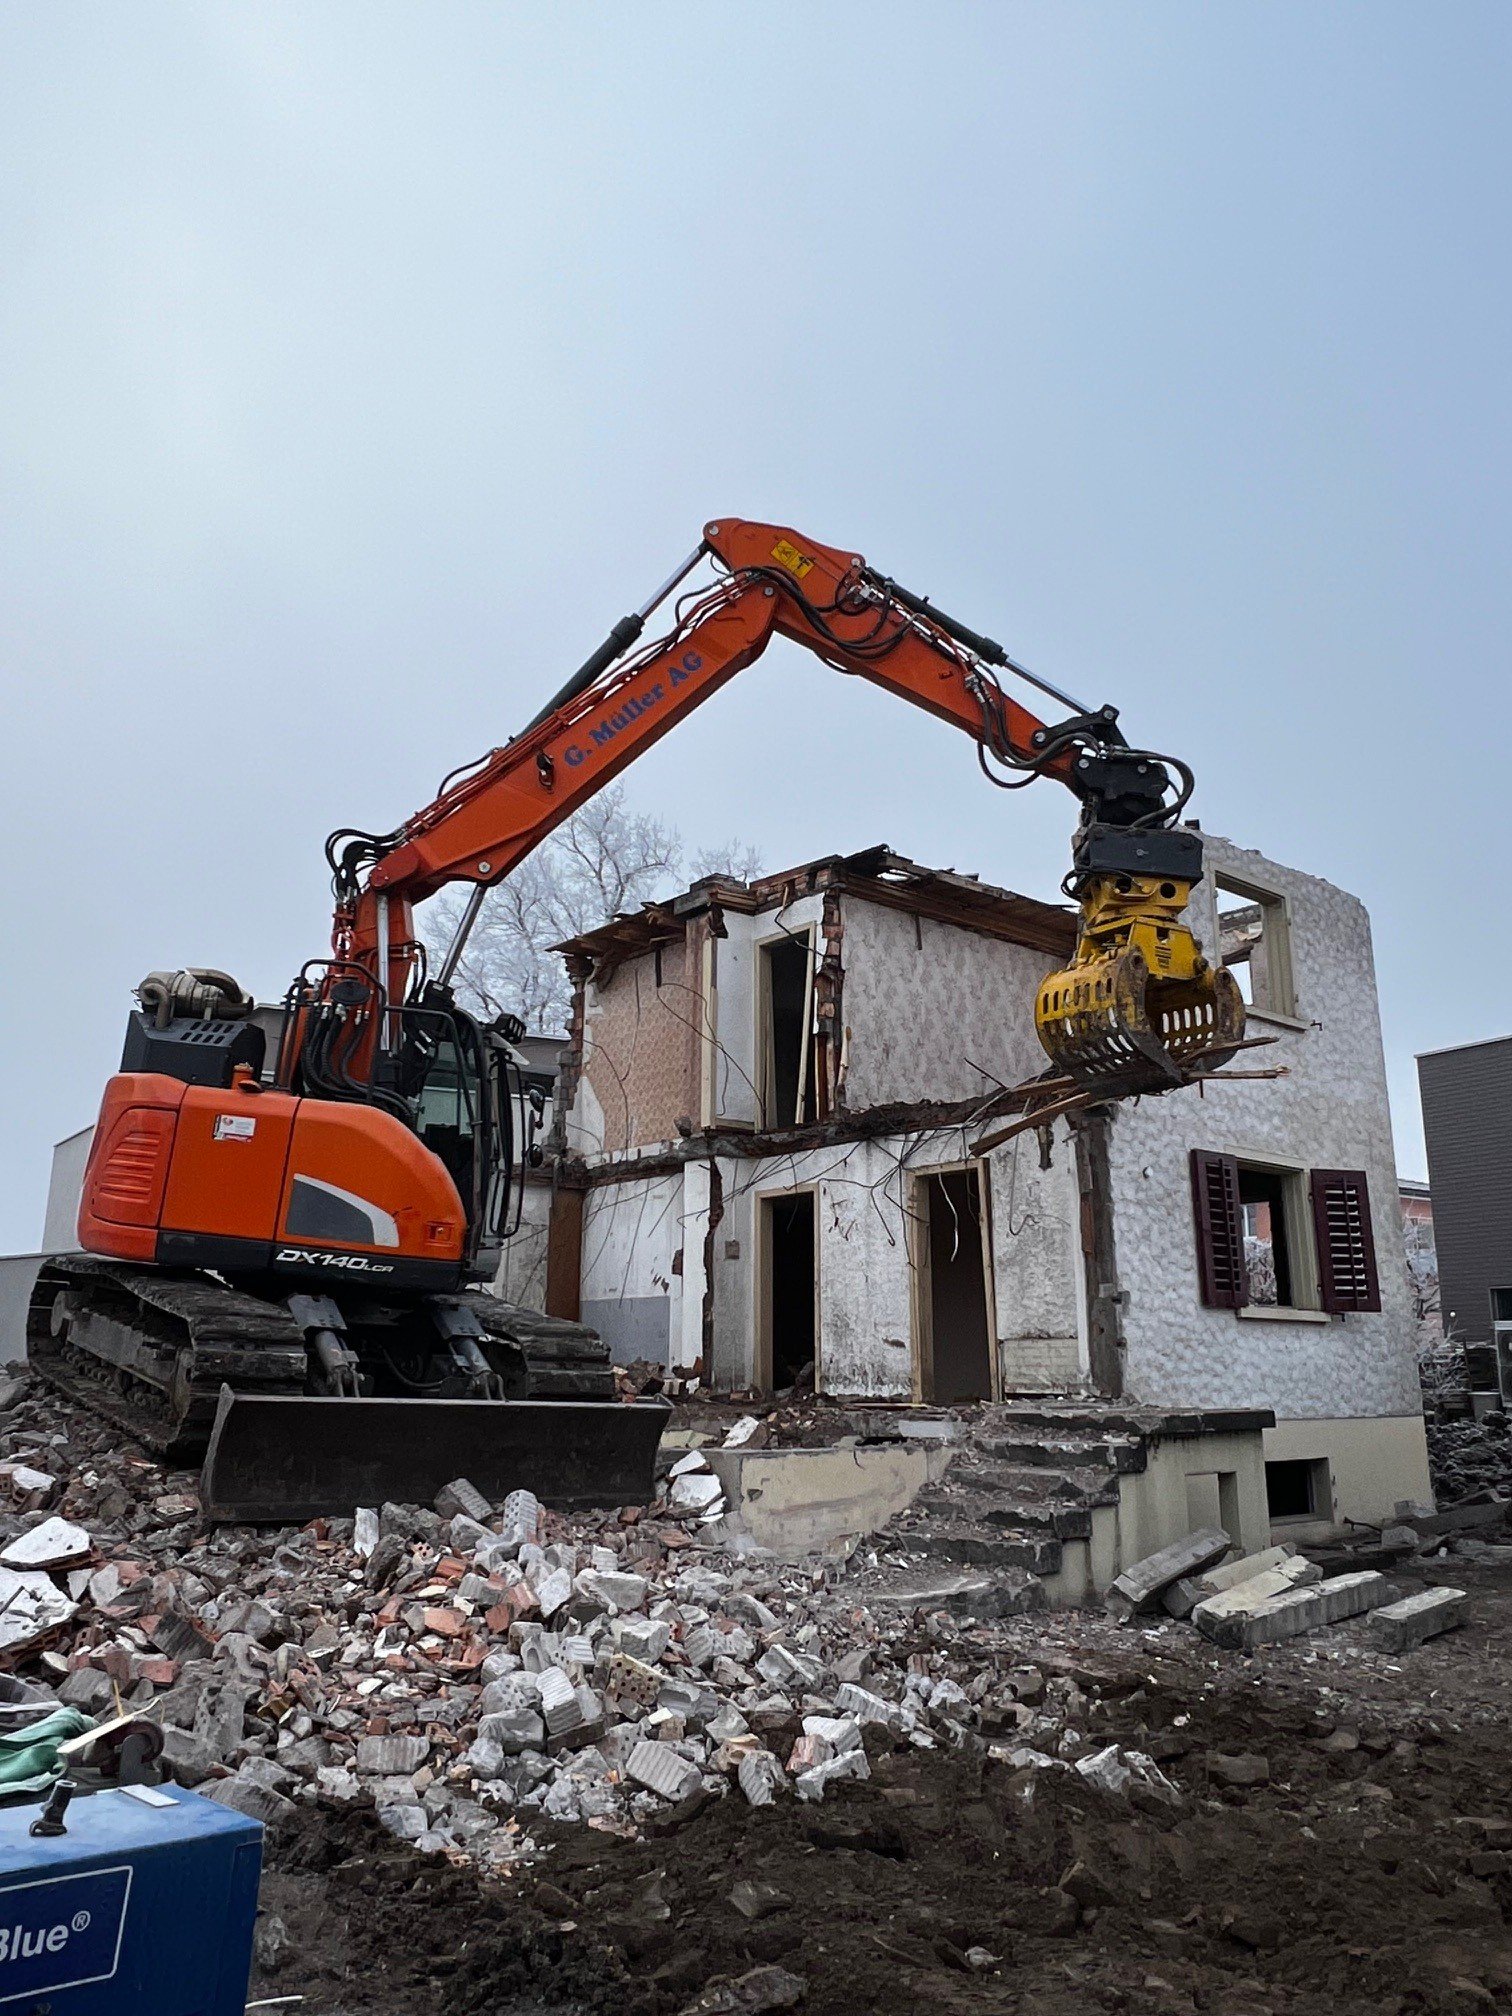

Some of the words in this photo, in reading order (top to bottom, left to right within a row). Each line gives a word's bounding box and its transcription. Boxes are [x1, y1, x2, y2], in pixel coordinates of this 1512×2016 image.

[564, 744, 593, 767] G.
[588, 682, 665, 747] Müller
[667, 651, 703, 687] AG
